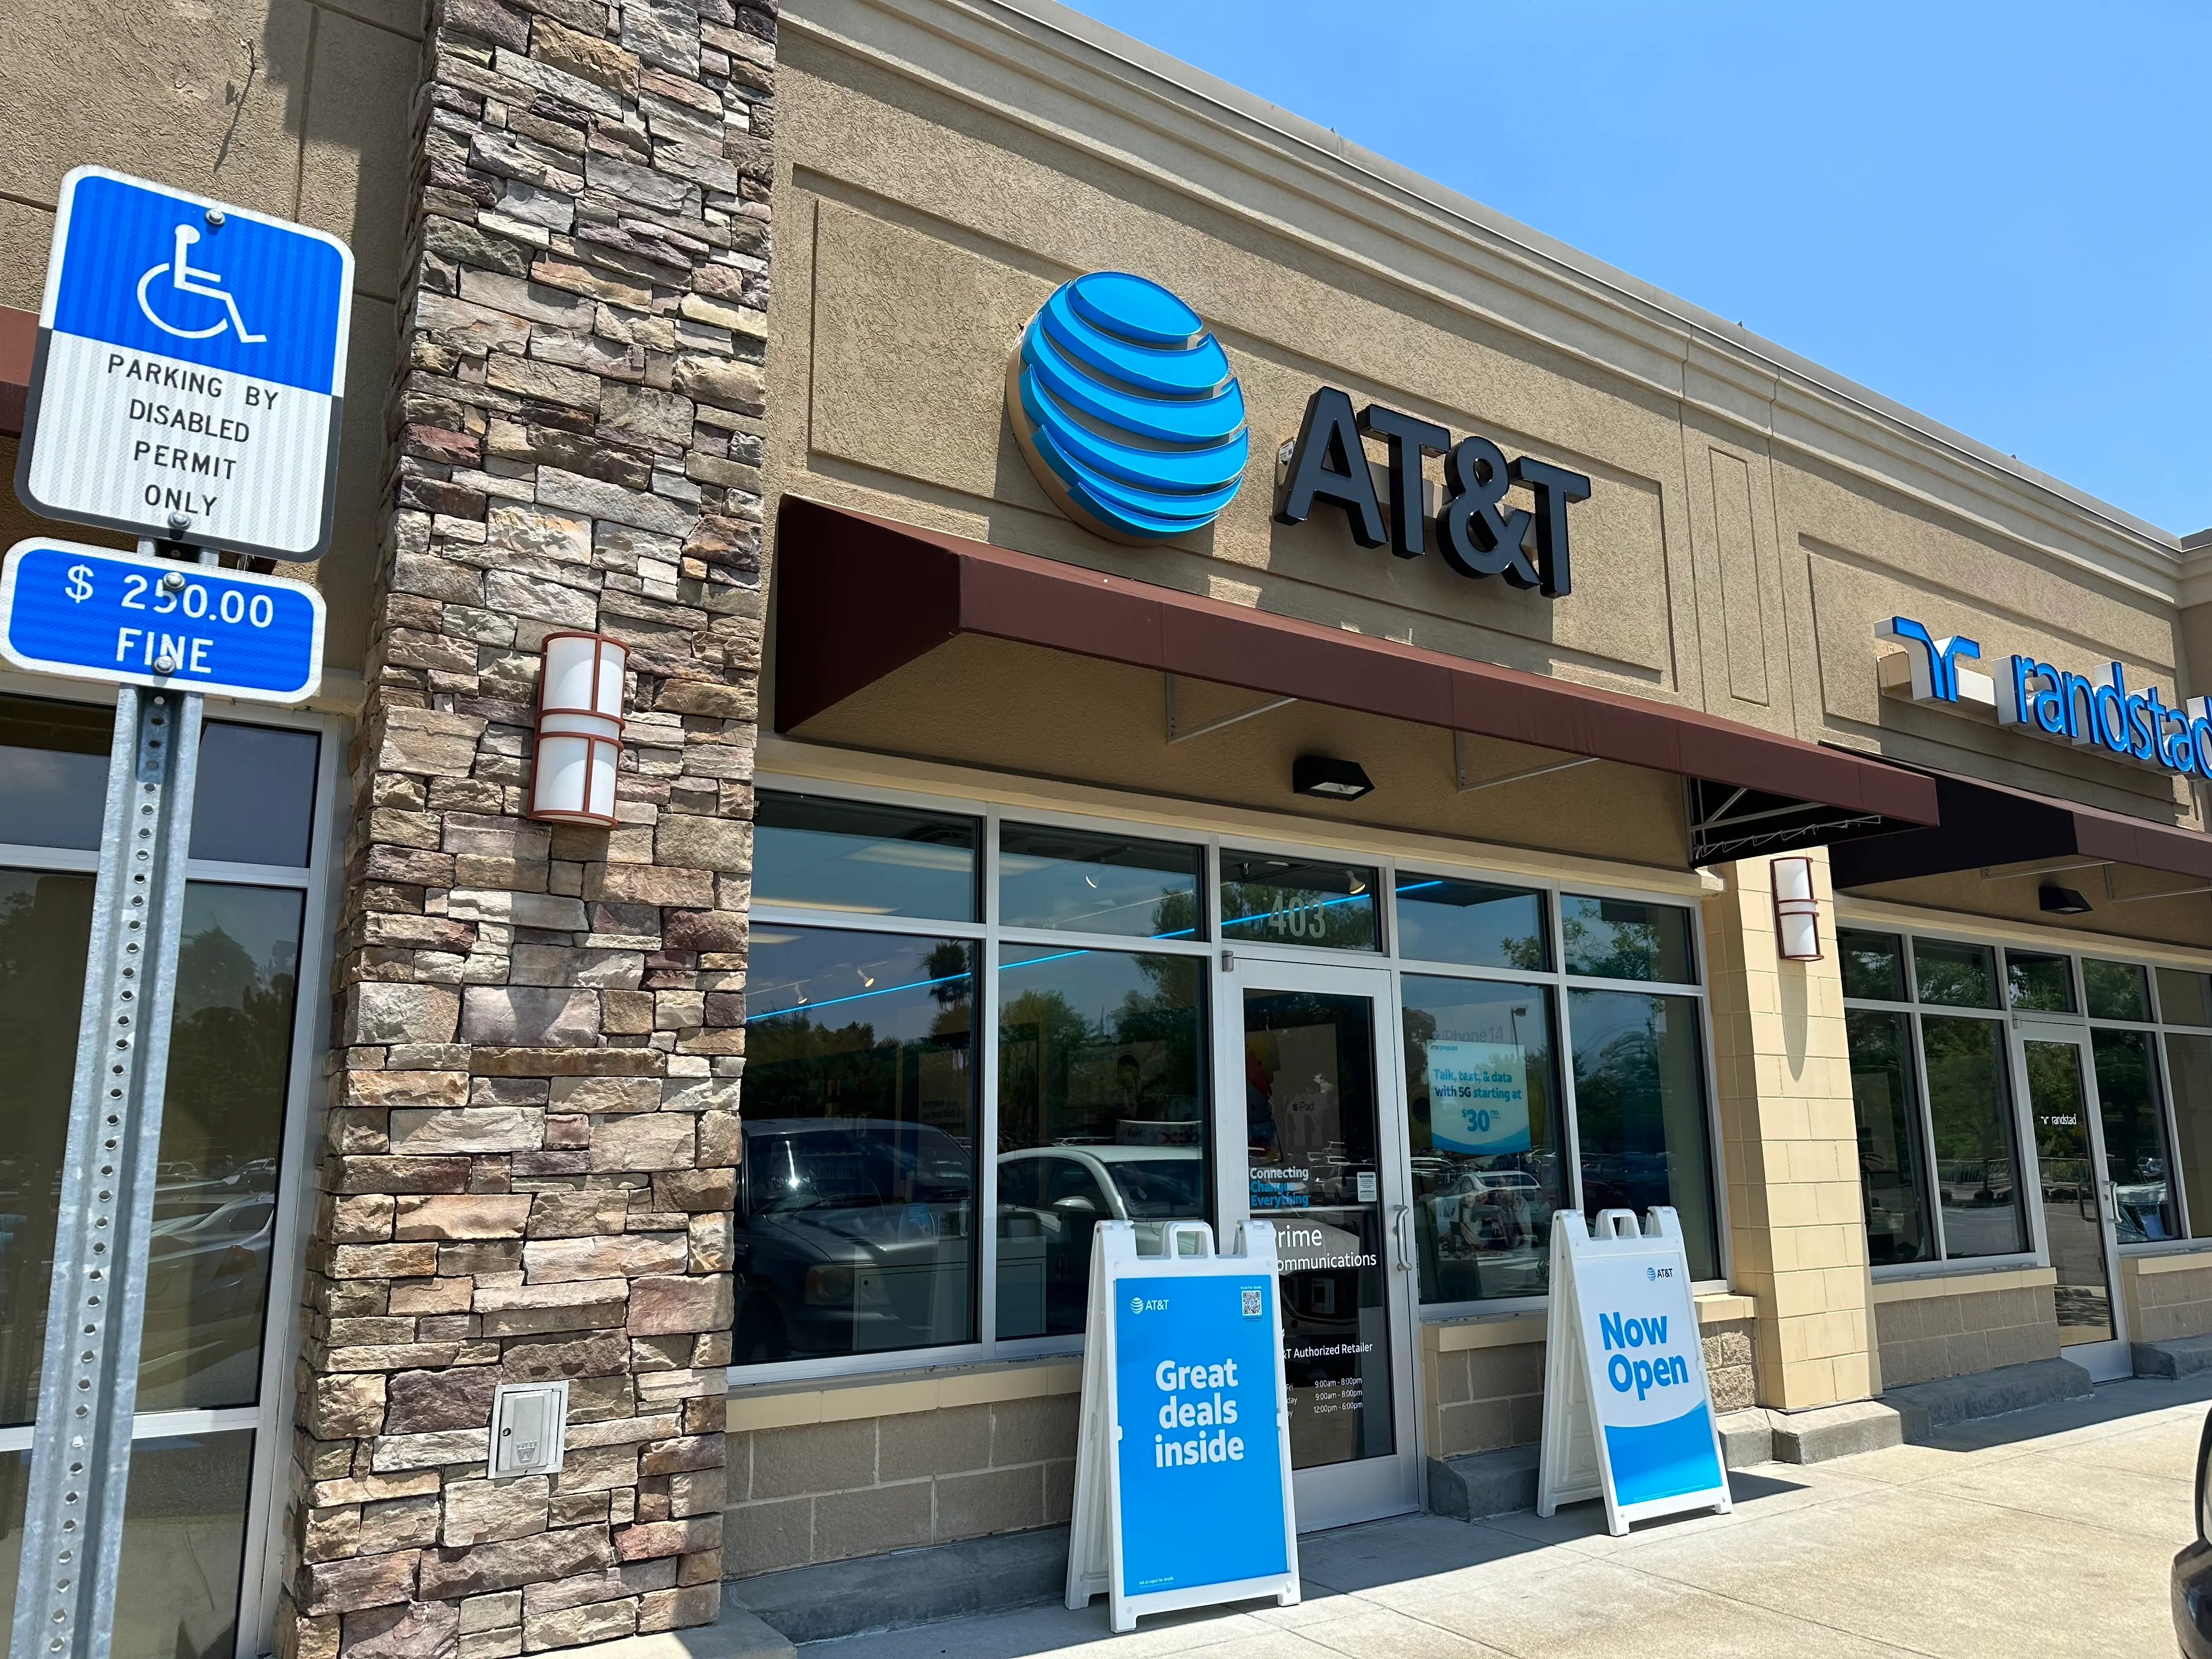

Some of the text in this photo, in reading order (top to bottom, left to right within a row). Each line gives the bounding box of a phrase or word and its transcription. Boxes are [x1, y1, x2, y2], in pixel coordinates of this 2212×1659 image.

[108, 354, 279, 410] PARKING BY
[129, 399, 250, 442] DISABLED
[134, 441, 236, 479] PERMIT
[145, 484, 217, 516] ONLY
[1273, 386, 1591, 598] AT&T
[65, 564, 273, 628] $ 250.00
[116, 627, 214, 673] FINE
[1269, 895, 1325, 938] 403
[1442, 1025, 1504, 1042] iPhone 14
[1434, 1069, 1513, 1084] Talk, text, & data
[1435, 1085, 1522, 1102] with 5G starting at
[1298, 1101, 1314, 1111] iPad
[2052, 1113, 2077, 1125] randstad
[1250, 1166, 1309, 1181] Connecting
[1251, 1192, 1309, 1209] Everything
[1276, 1224, 1323, 1248] rime
[1278, 1251, 1376, 1271] ommunications
[1657, 1268, 1673, 1278] AT&T
[1145, 1299, 1170, 1311] AT&T
[1599, 1312, 1668, 1351] Now
[1294, 1344, 1340, 1358] Authorized
[1341, 1342, 1373, 1354] Retailer
[1155, 1358, 1239, 1391] Great
[1315, 1380, 1336, 1389] 9:00am
[1341, 1377, 1363, 1386] 8:00pm
[1608, 1353, 1689, 1401] Open
[1315, 1392, 1337, 1401] 9:00am
[1341, 1389, 1363, 1398] 8:00pm
[1159, 1392, 1238, 1429] deals
[1313, 1404, 1338, 1414] 12:00pm
[1342, 1401, 1363, 1410] 6:00pm
[1155, 1429, 1244, 1468] inside
